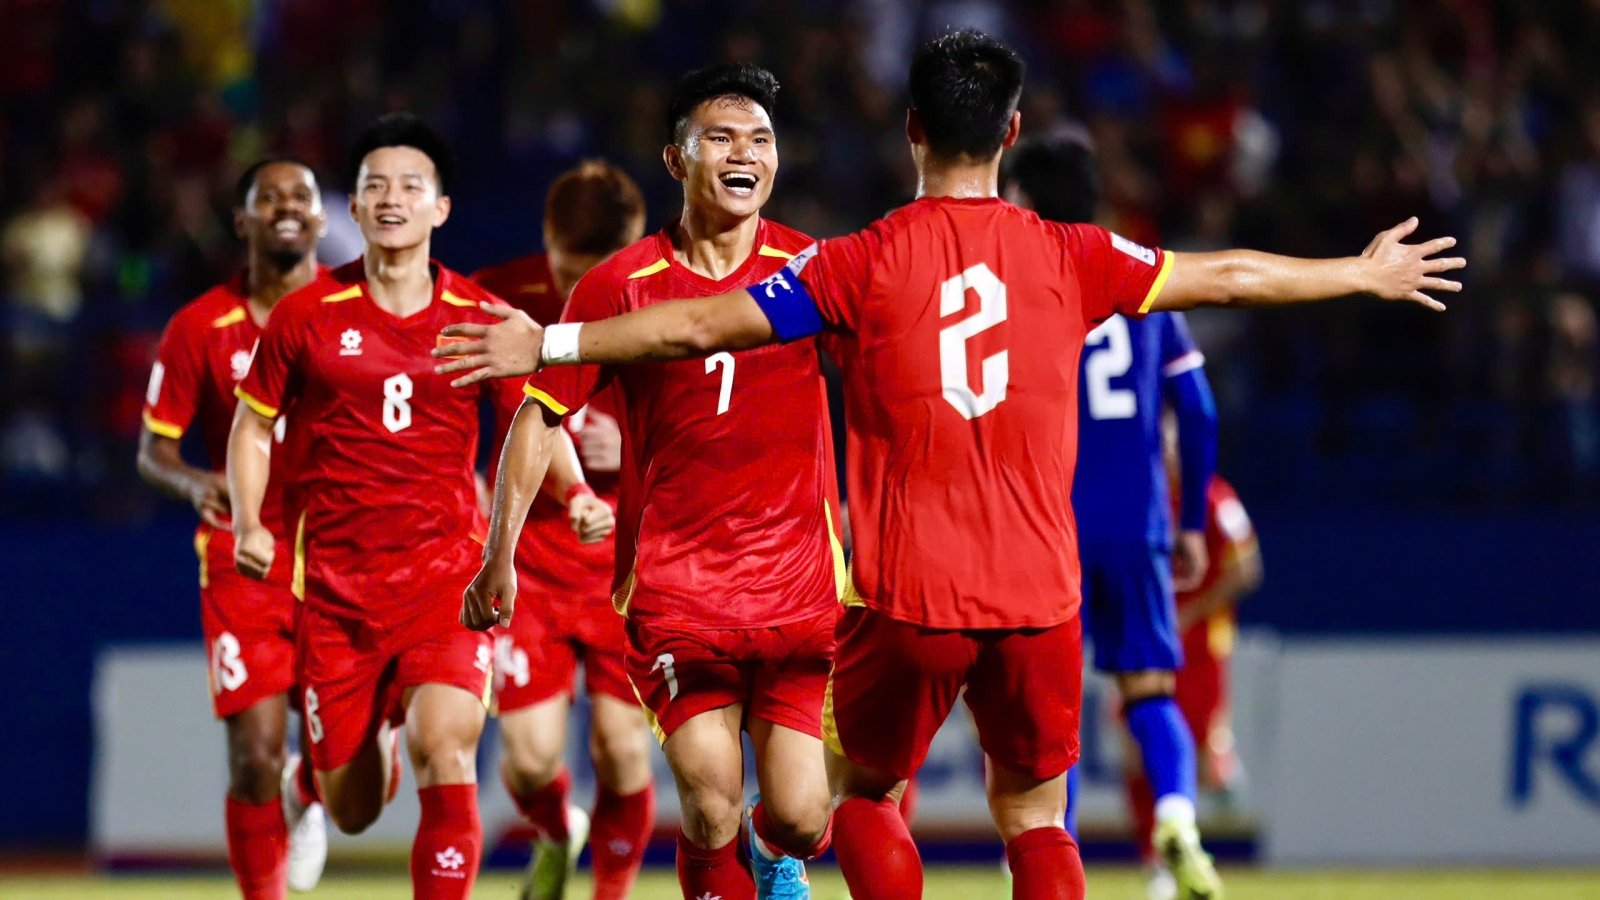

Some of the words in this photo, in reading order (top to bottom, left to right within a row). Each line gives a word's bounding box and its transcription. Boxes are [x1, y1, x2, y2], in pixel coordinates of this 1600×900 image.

[939, 262, 1009, 420] 2
[1085, 312, 1137, 420] 2
[383, 372, 413, 434] 8
[705, 351, 736, 416] 7
[211, 631, 249, 696] 13
[649, 652, 679, 702] 7
[304, 684, 325, 744] 8
